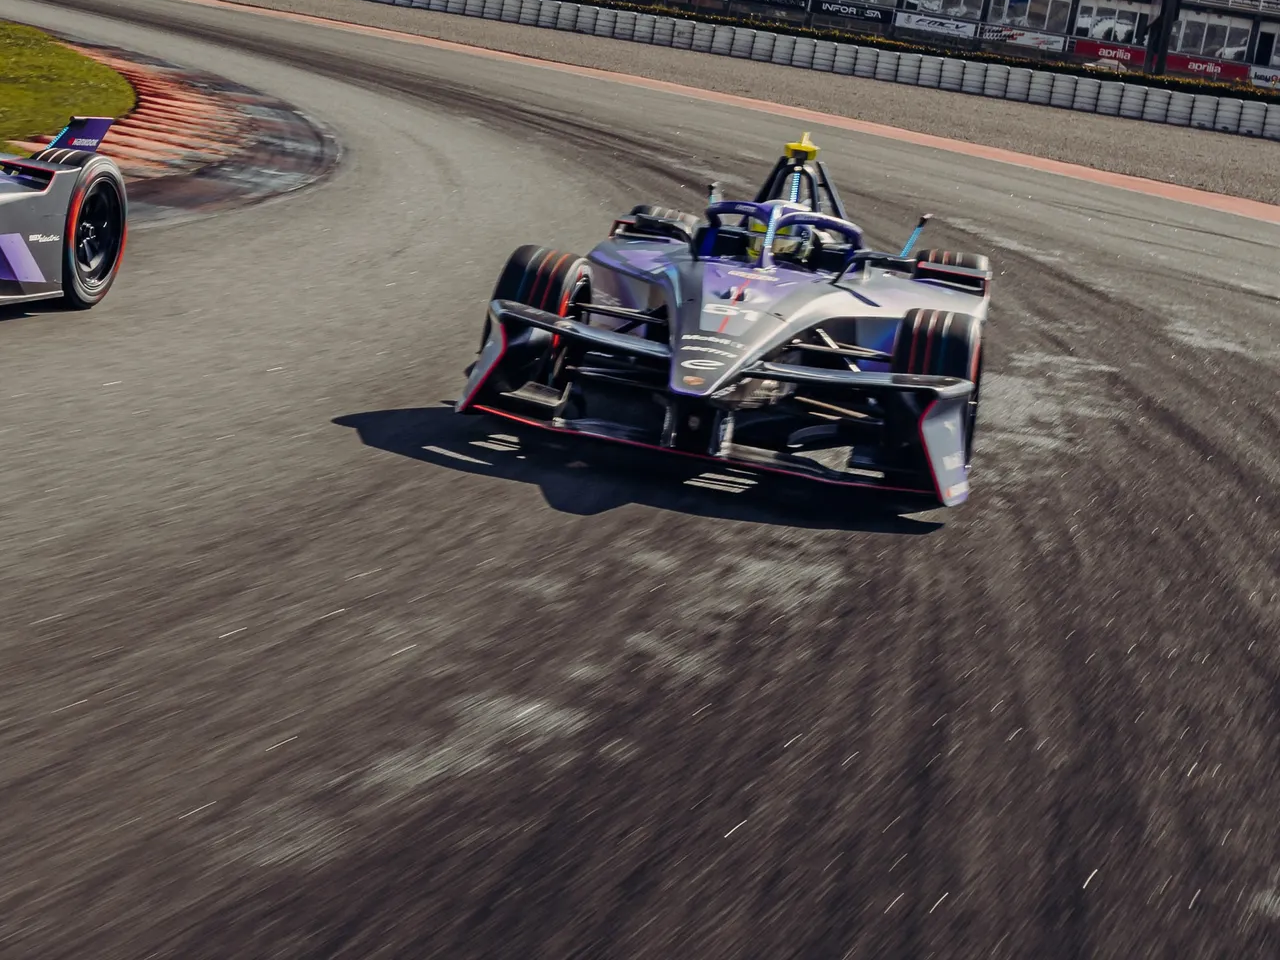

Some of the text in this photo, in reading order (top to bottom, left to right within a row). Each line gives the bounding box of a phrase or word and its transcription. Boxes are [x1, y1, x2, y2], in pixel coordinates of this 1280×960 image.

[1098, 47, 1131, 60] aprilia
[1188, 60, 1222, 74] aprilia
[702, 303, 758, 321] 51
